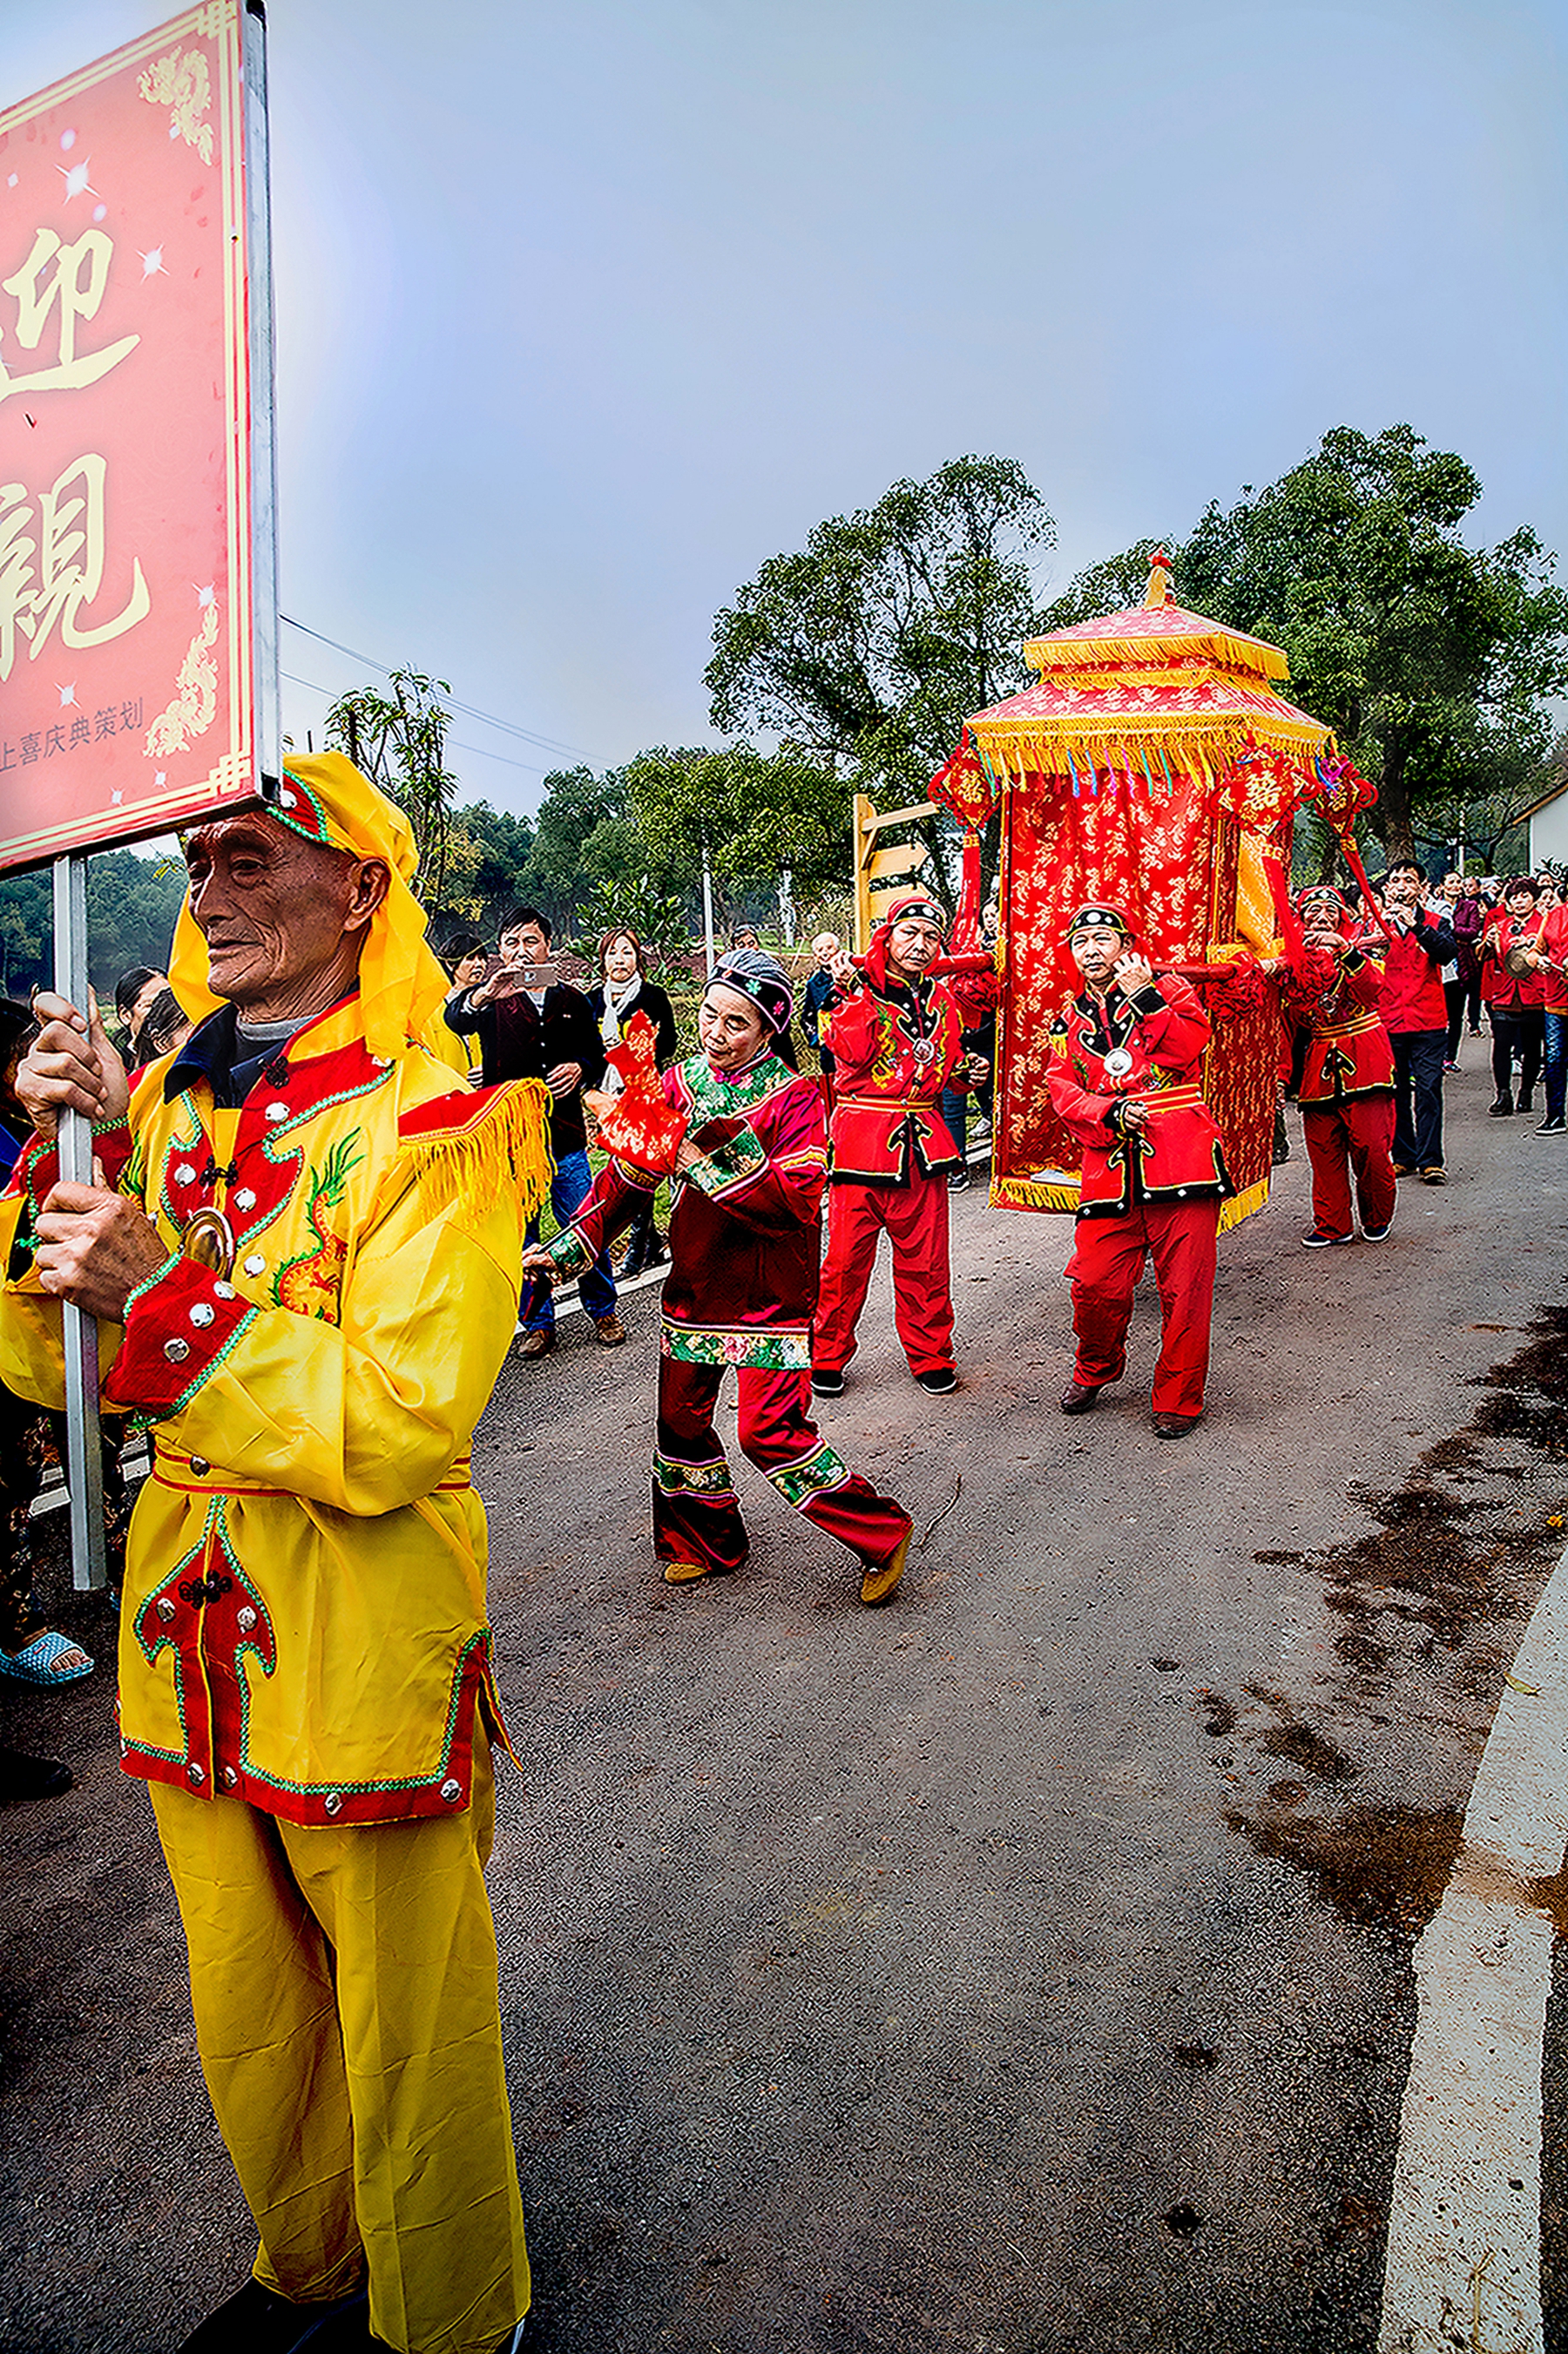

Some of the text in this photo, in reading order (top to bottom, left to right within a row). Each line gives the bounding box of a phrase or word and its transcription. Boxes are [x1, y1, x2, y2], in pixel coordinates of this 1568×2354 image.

[0, 697, 143, 772] 上喜庆典策划
